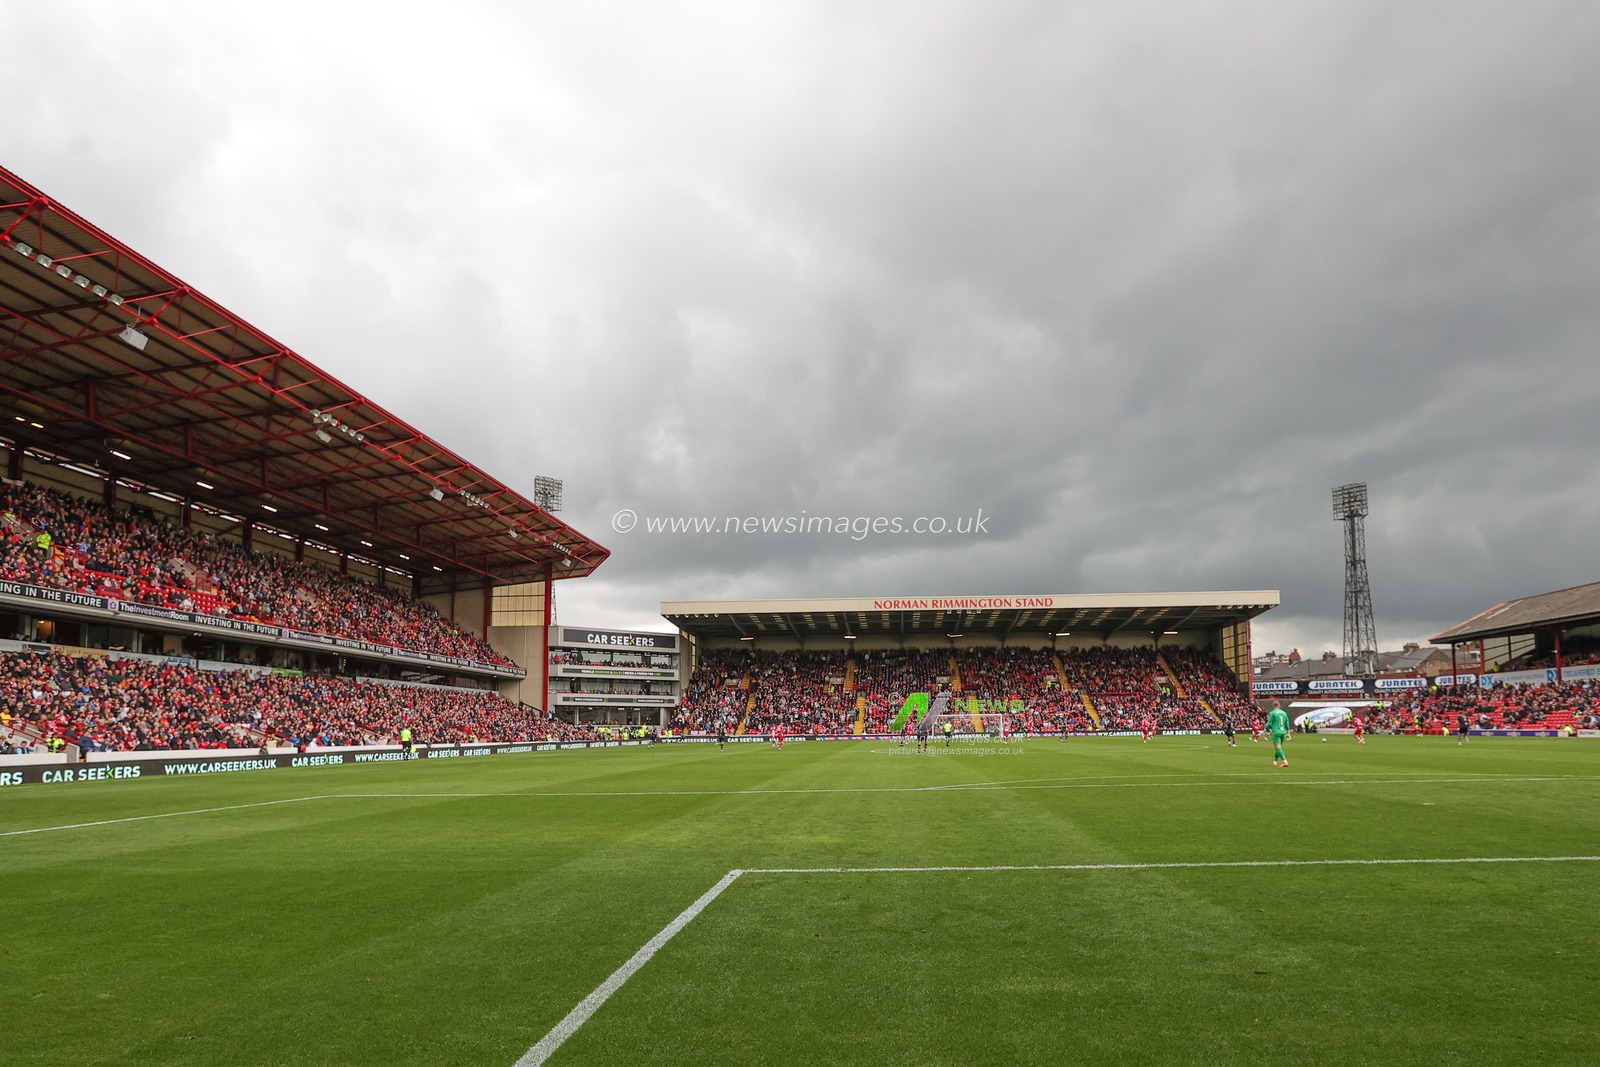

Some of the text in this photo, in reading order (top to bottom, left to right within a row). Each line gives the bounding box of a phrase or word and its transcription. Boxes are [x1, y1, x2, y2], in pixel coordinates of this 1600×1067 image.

[25, 586, 37, 596] IN
[41, 589, 61, 600] THE
[65, 593, 101, 607] FUTURE
[874, 597, 1053, 609] NORMAN RIMMINGTON STAND
[195, 615, 279, 635] INVESTING IN THE FUTURE
[336, 639, 360, 649] INVESTING
[587, 633, 655, 647] CAR SEEKERS
[1439, 676, 1472, 684] JURTEK
[1481, 676, 1494, 686] DX
[292, 753, 343, 767] CAR SEEKERS
[428, 750, 438, 758] CAR
[42, 764, 141, 783] CAR SEEKERS
[165, 759, 277, 775] WWW.CARSEEKERS.UK
